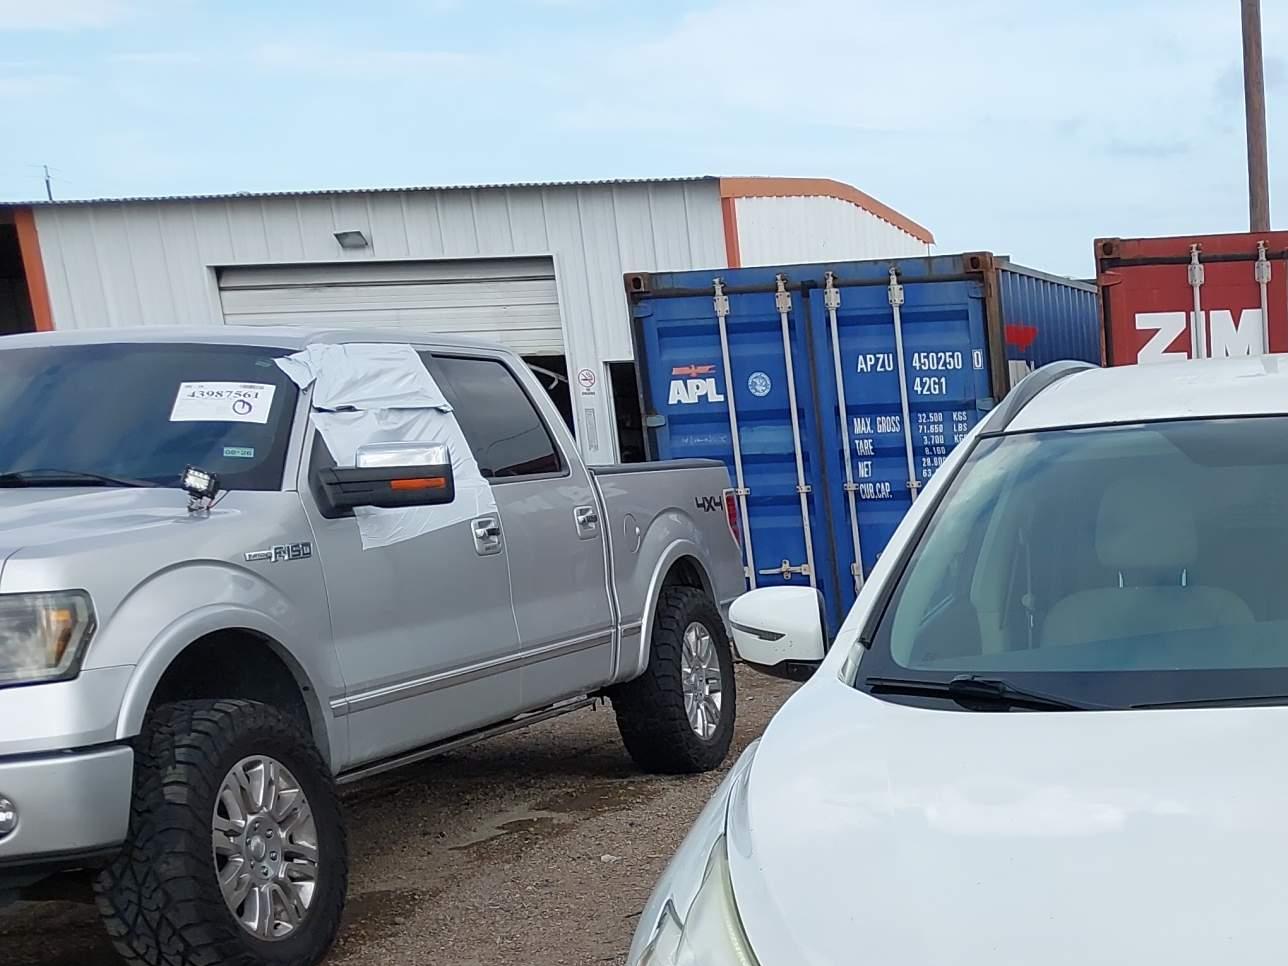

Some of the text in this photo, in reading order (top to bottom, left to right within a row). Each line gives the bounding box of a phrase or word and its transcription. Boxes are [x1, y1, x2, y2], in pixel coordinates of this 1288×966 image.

[1135, 308, 1263, 365] ZIM
[857, 353, 894, 373] APZU
[912, 351, 962, 370] 450250
[187, 389, 260, 399] 43987561
[668, 378, 725, 405] APL
[913, 376, 946, 395] 42G1
[853, 415, 901, 434] MAX. GROSS
[953, 411, 967, 421] KGS
[954, 423, 968, 432] LBS
[855, 439, 875, 456] TARE
[858, 461, 872, 478] NET
